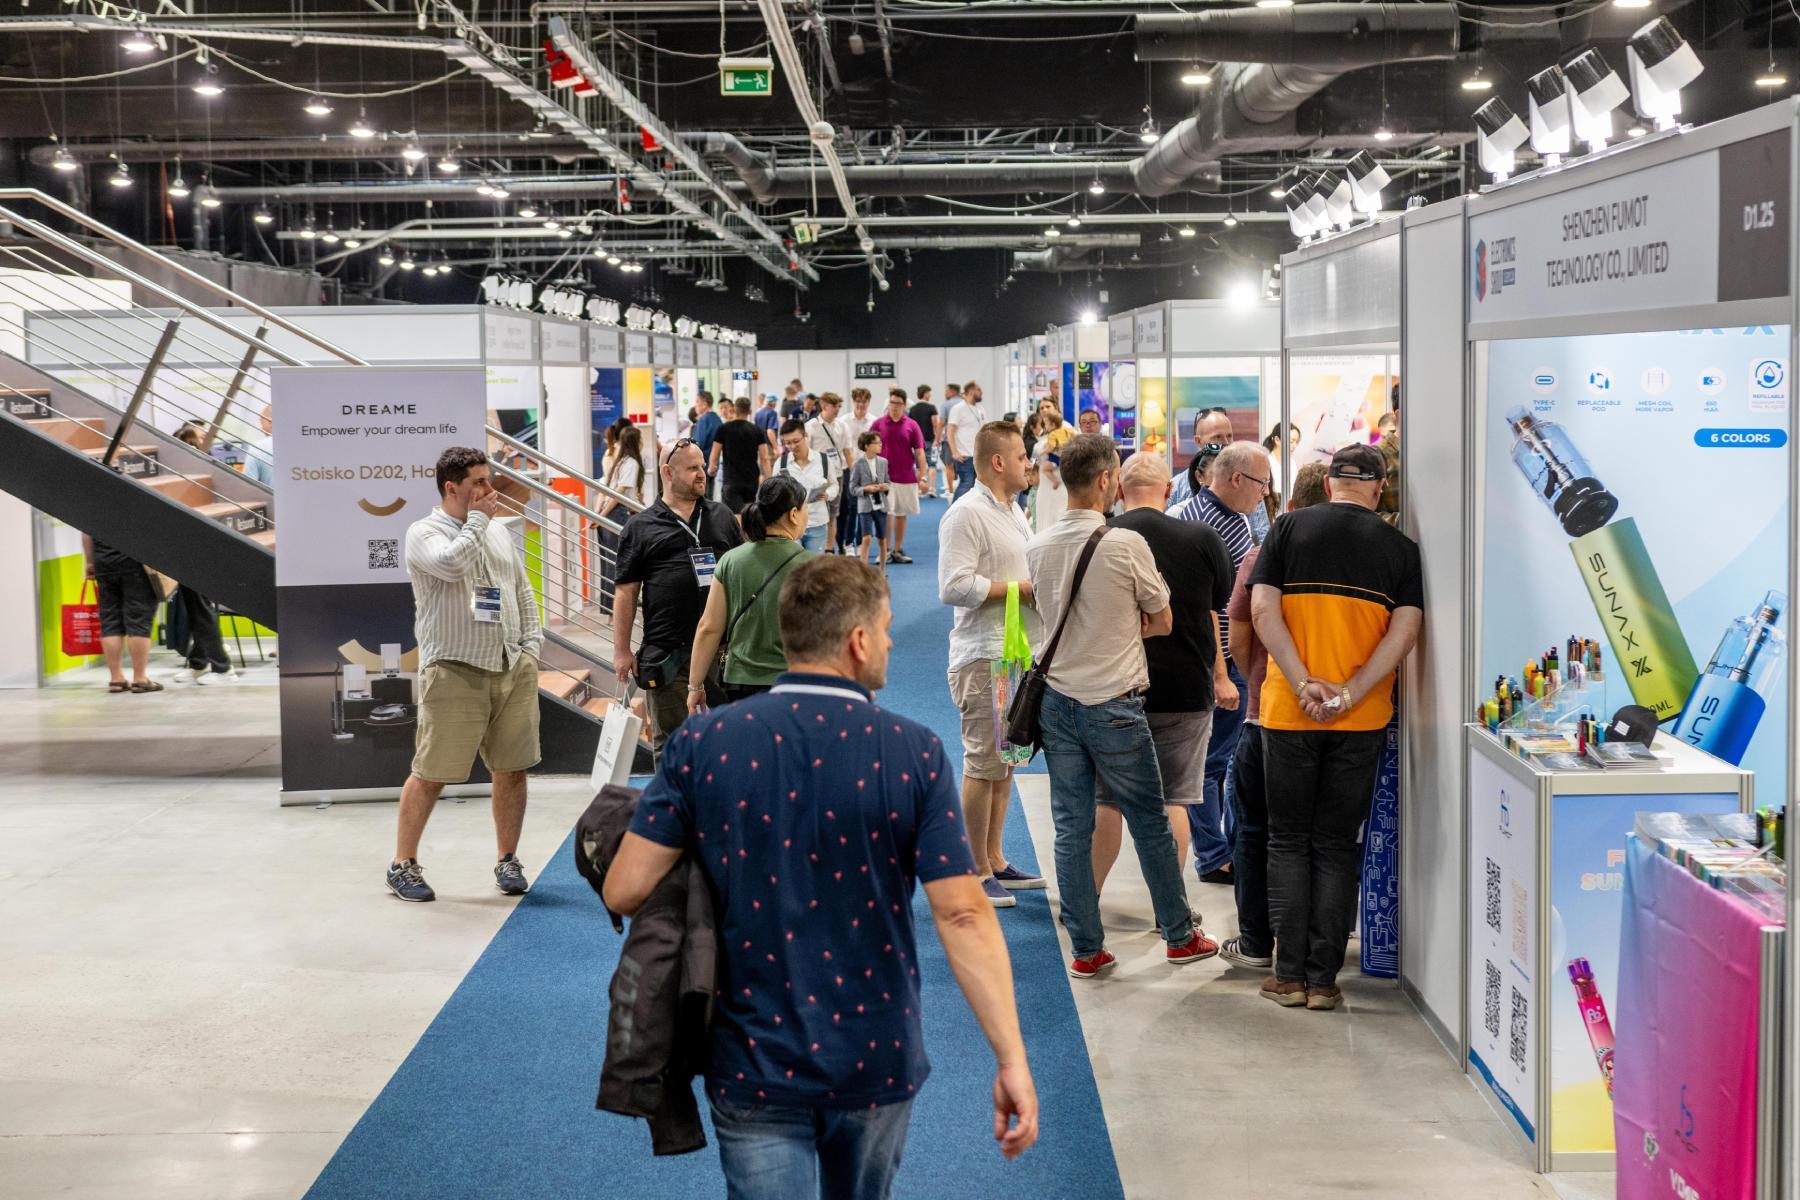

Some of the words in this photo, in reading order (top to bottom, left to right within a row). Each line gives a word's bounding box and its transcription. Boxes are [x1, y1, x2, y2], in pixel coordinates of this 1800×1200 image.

[1562, 204, 1610, 242] SHENZHEN
[1612, 195, 1649, 232] FUMOT
[1744, 200, 1775, 231] D1.25
[1546, 251, 1606, 288] TECHNOLOGY
[1627, 241, 1669, 277] LIMITED
[342, 404, 417, 415] DREAME
[301, 425, 361, 437] Empower
[364, 425, 391, 437] your
[395, 424, 436, 435] dream
[439, 423, 457, 434] life
[1710, 433, 1719, 443] 6
[1721, 433, 1771, 443] COLORS
[291, 465, 355, 481] Stoisko
[360, 465, 407, 481] D202,
[412, 465, 437, 478] Ha
[1687, 695, 1720, 745] SUN
